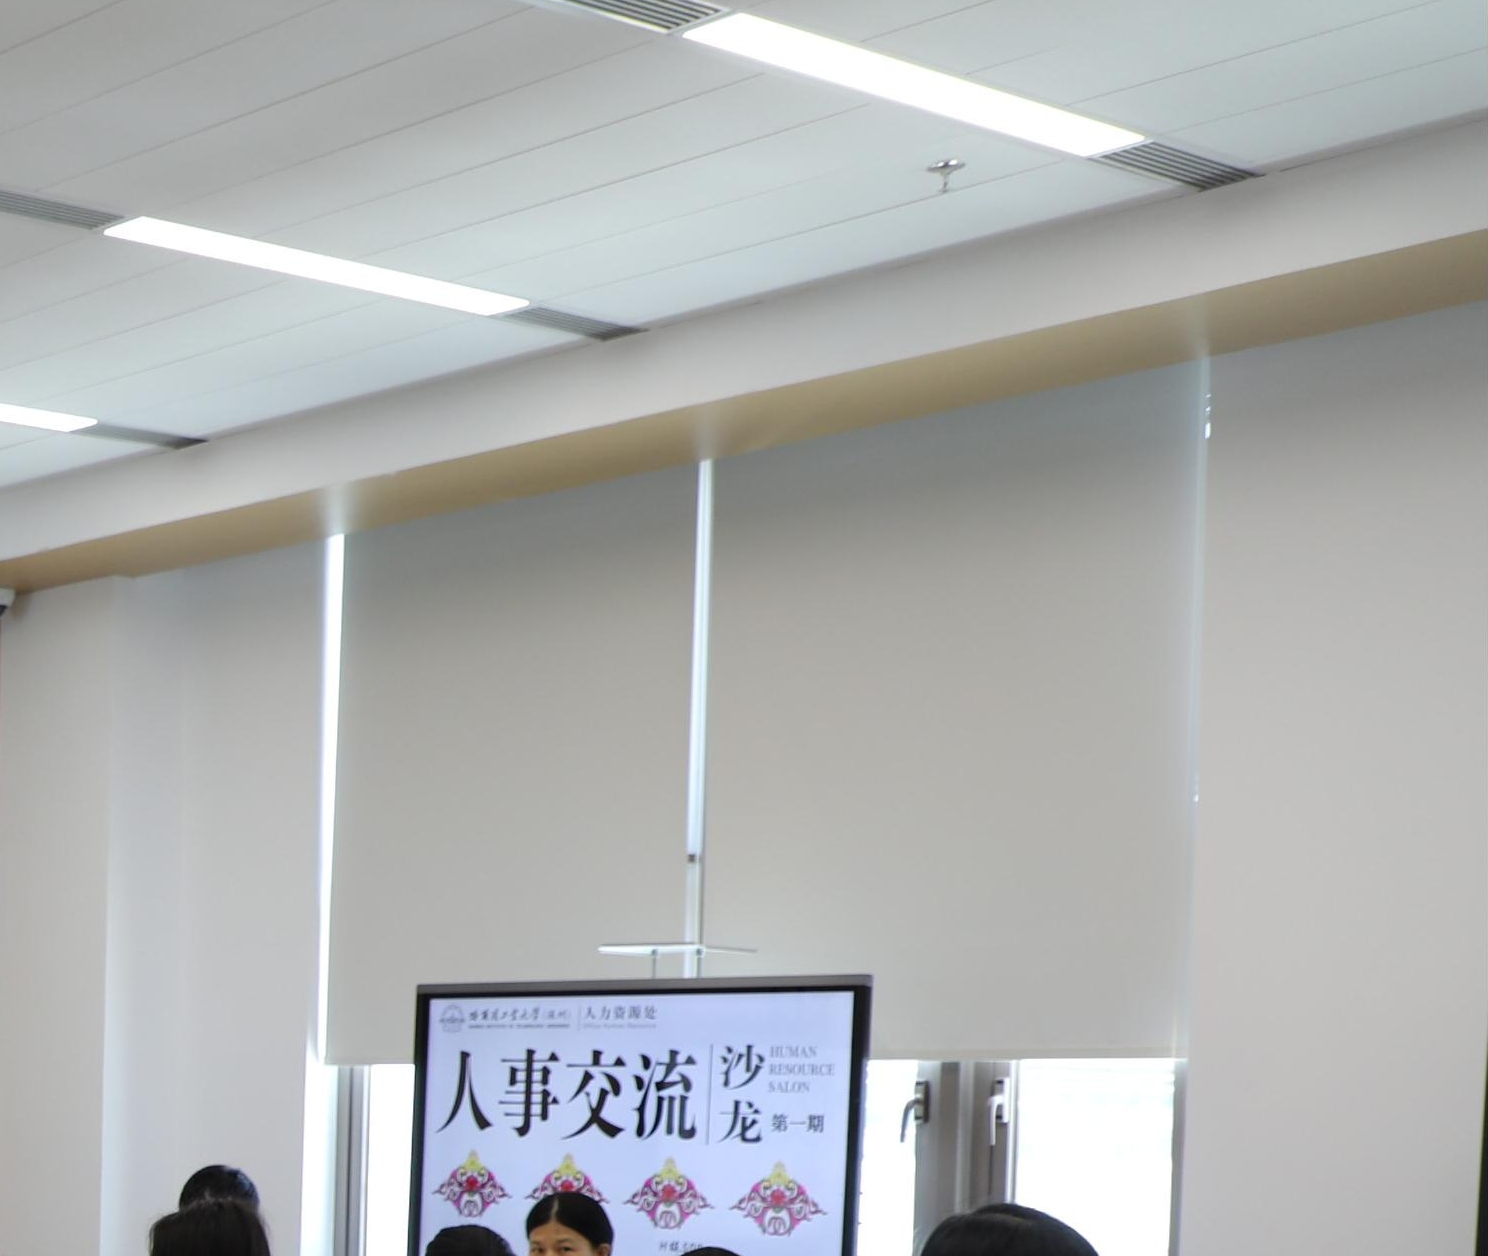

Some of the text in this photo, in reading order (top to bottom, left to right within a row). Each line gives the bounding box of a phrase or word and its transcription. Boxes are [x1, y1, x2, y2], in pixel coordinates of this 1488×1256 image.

[769, 1046, 818, 1059] HUMAN
[768, 1062, 836, 1077] RESOURCE
[436, 1048, 698, 1141] 人事交流
[718, 1044, 766, 1144] 沙龙
[767, 1080, 811, 1094] SALON
[770, 1112, 826, 1134] 第一期
